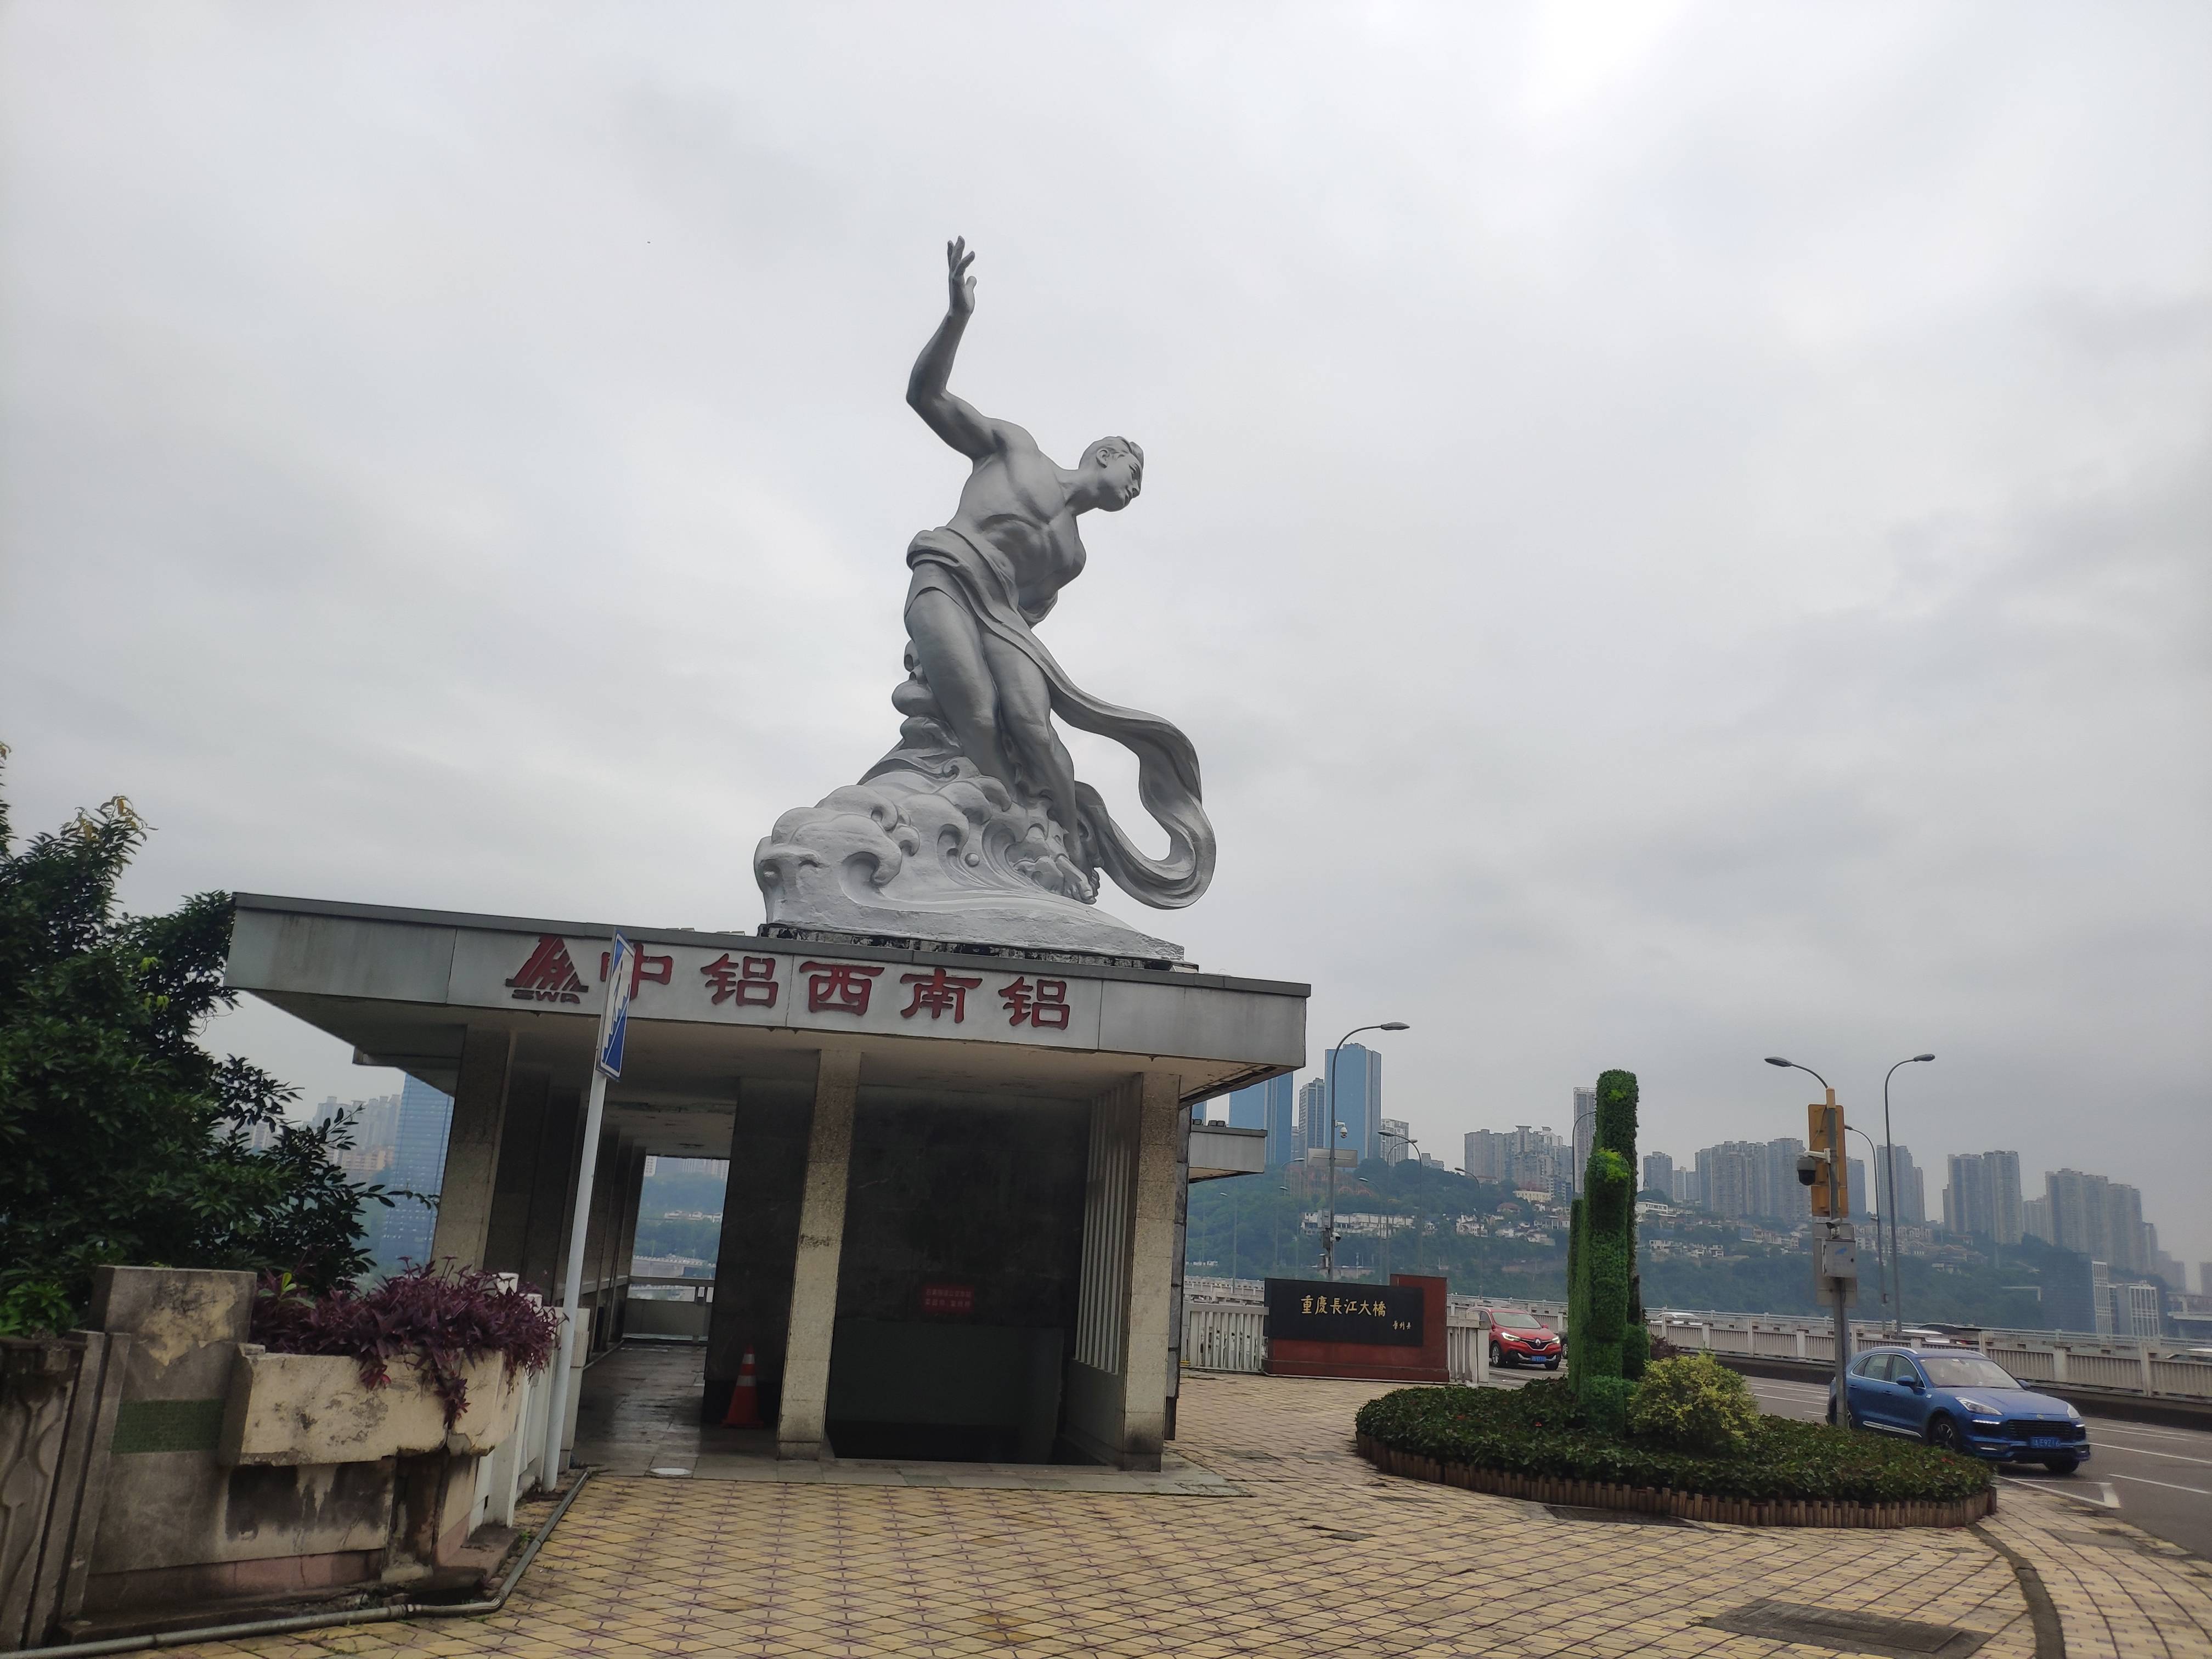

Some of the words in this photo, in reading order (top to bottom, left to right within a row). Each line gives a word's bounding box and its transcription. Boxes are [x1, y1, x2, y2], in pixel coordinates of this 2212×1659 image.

[1300, 1295, 1387, 1317] 重慶長江大橋
